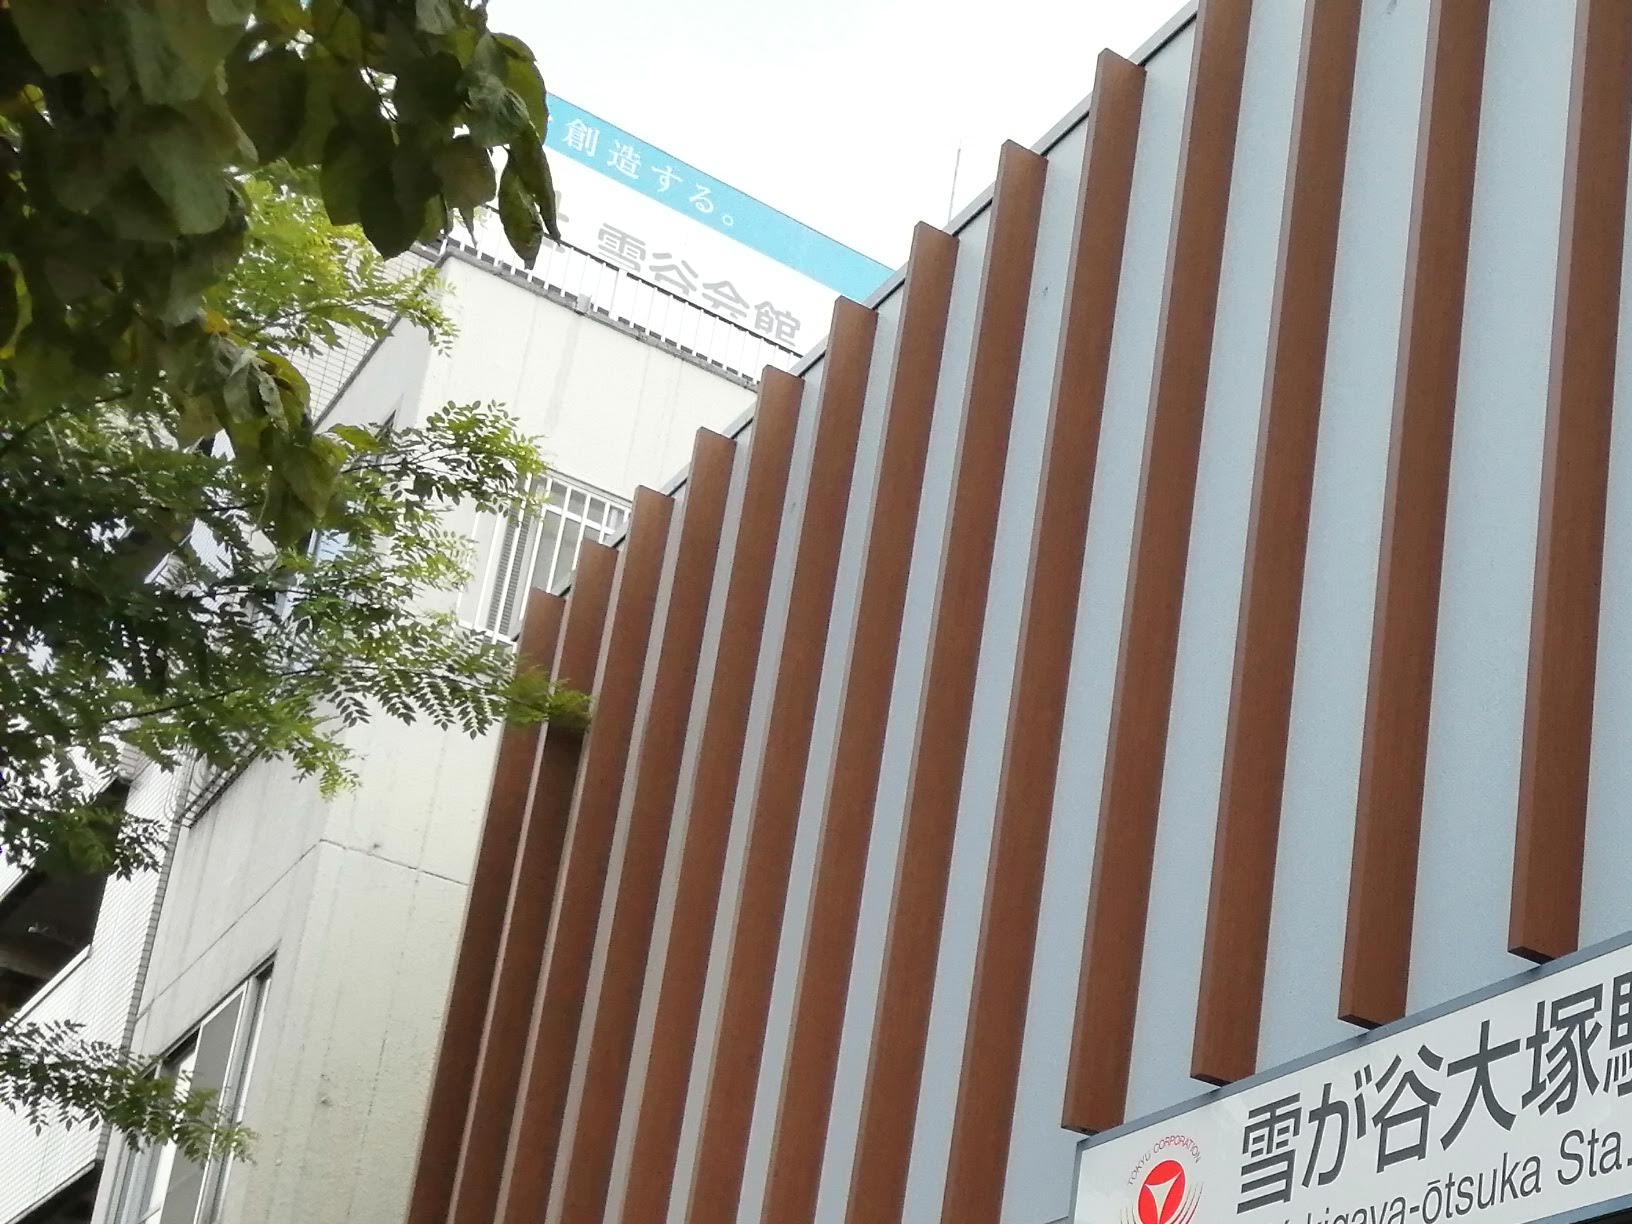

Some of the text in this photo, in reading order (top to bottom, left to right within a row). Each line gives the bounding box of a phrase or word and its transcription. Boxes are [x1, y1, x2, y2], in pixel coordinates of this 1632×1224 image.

[548, 112, 736, 228] 創造する。
[1127, 1134, 1202, 1186] TOKYU CORPORATION
